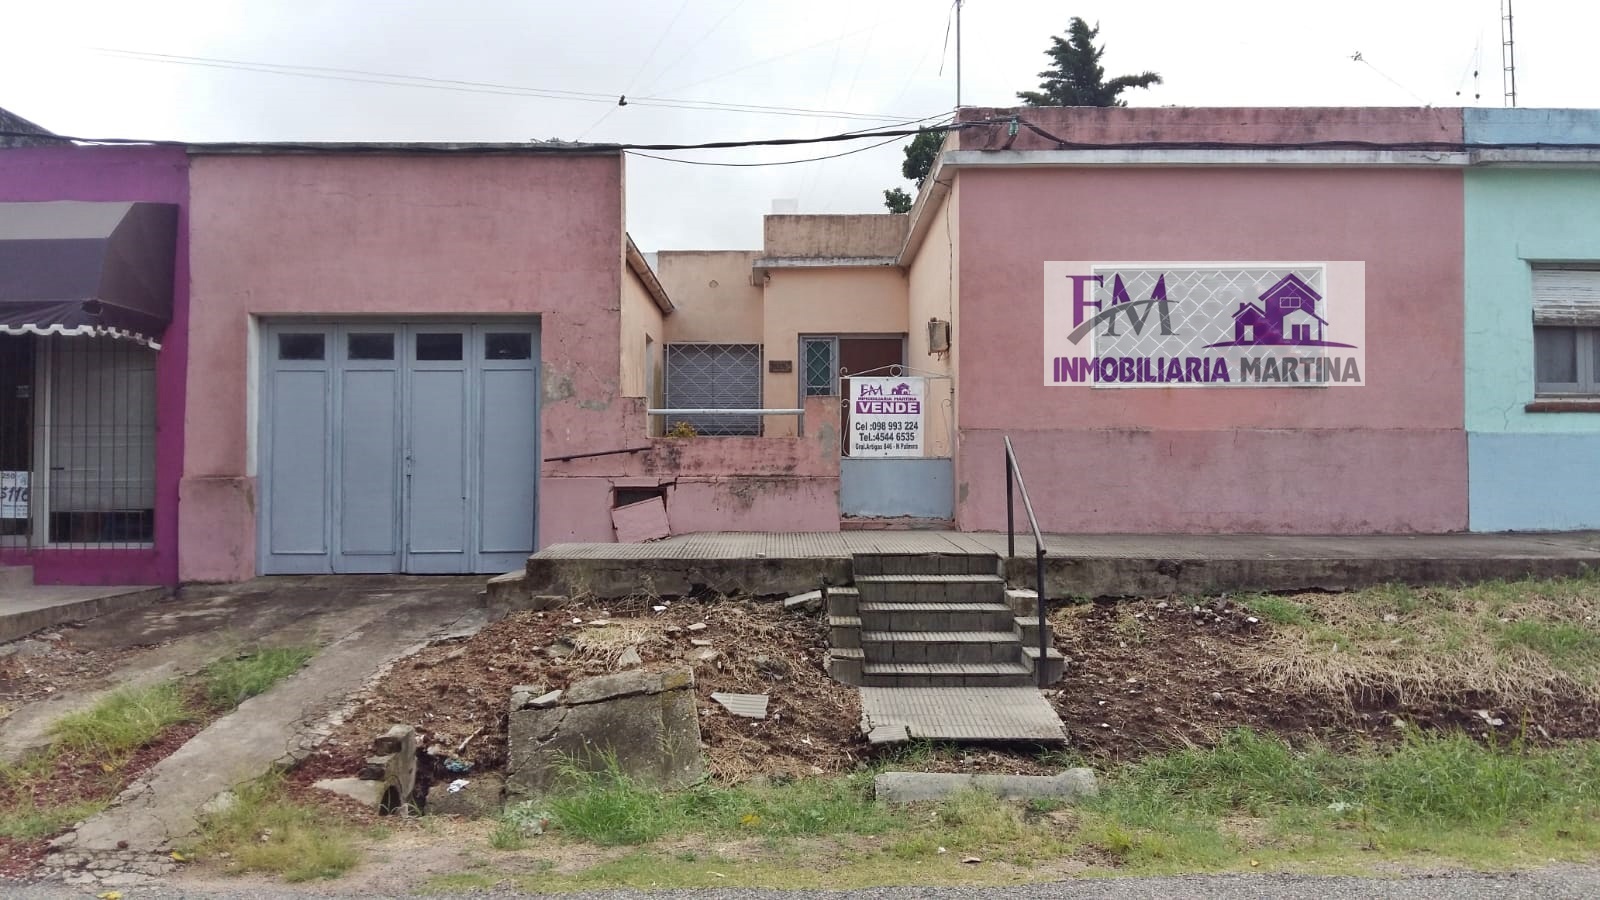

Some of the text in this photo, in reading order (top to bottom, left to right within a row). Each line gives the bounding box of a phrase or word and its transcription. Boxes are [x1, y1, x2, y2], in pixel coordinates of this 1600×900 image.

[859, 402, 918, 413] VENDE
[888, 422, 902, 431] 993
[904, 422, 918, 431] 224
[896, 432, 915, 442] 6535
